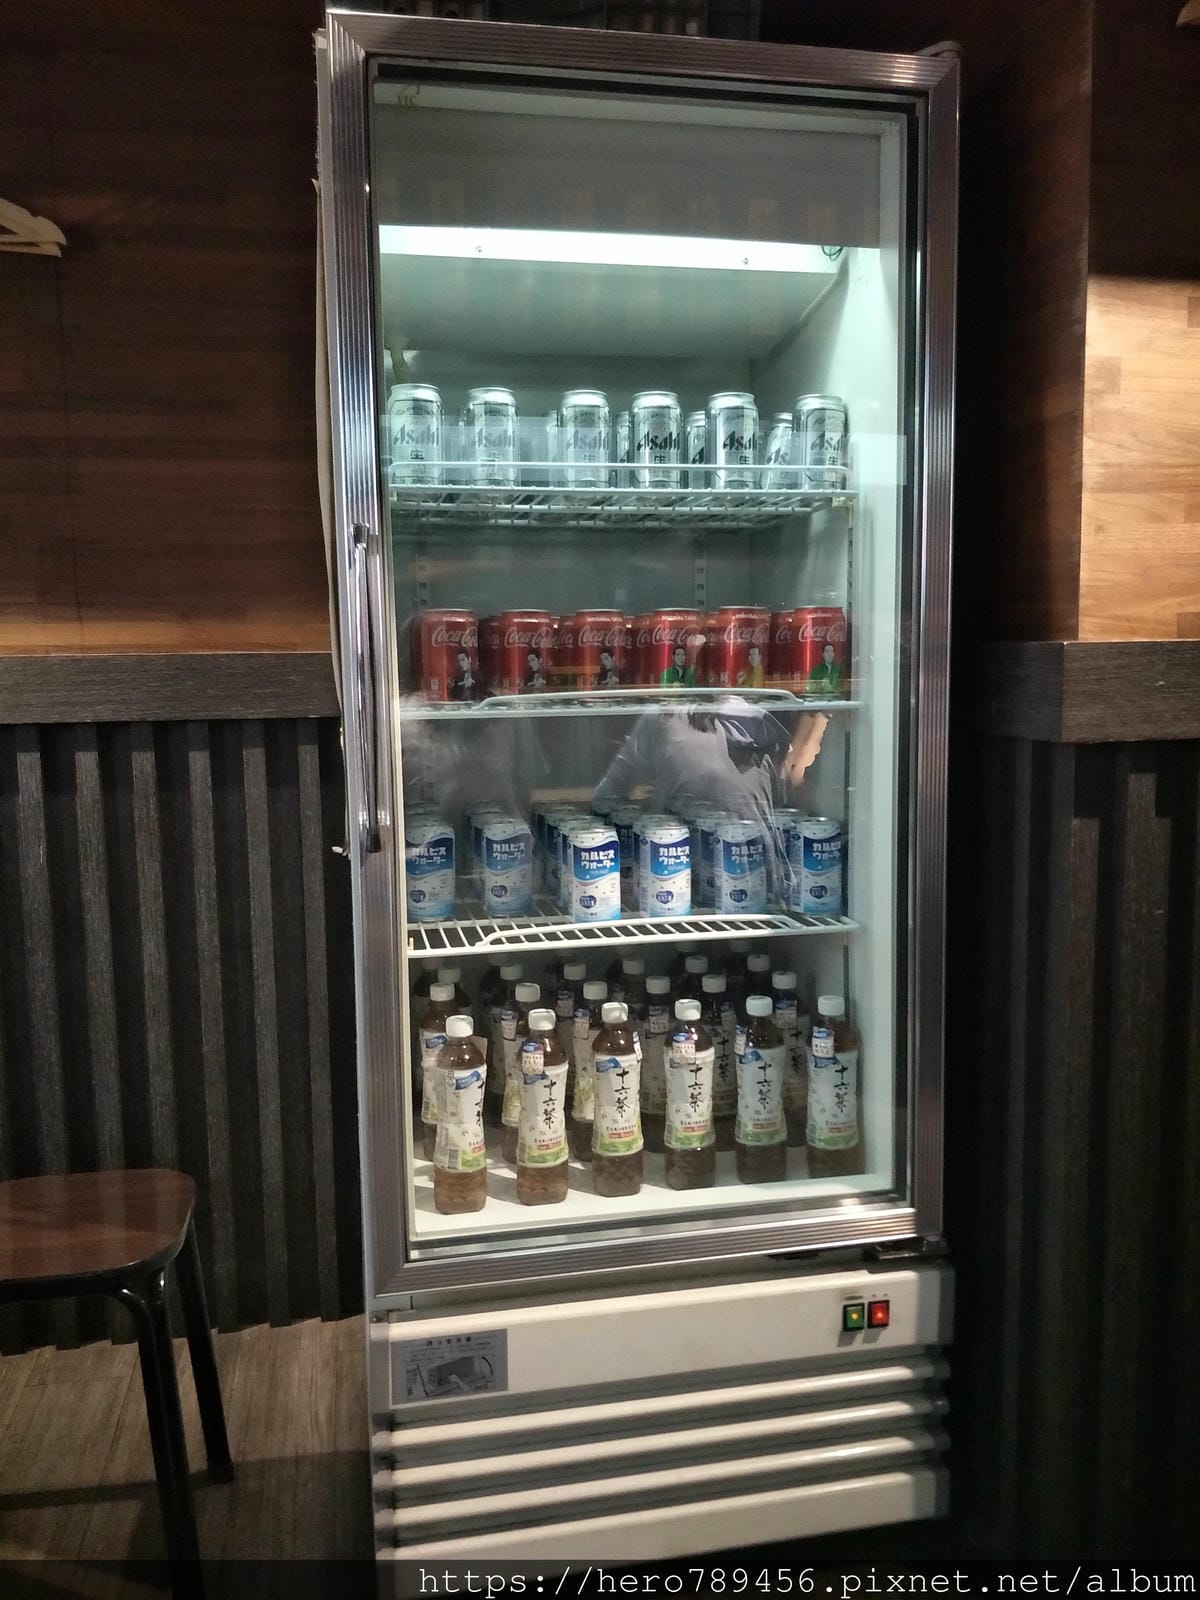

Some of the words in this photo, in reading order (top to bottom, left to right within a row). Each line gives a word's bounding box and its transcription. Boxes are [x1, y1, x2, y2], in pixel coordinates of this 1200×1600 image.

[393, 424, 440, 446] Asahi
[637, 430, 681, 452] Asahi
[431, 625, 478, 648] Coca-Col
[492, 842, 526, 853] カルピス
[581, 849, 615, 861] カルピス
[659, 845, 690, 857] カルピス
[581, 859, 615, 870] ウォーター
[614, 1067, 632, 1119] 十六茶
[687, 1063, 704, 1113] 十六茶
[756, 1061, 773, 1110] 十六茶
[833, 1064, 850, 1114] 十六茶
[542, 1078, 558, 1130] 十六茶
